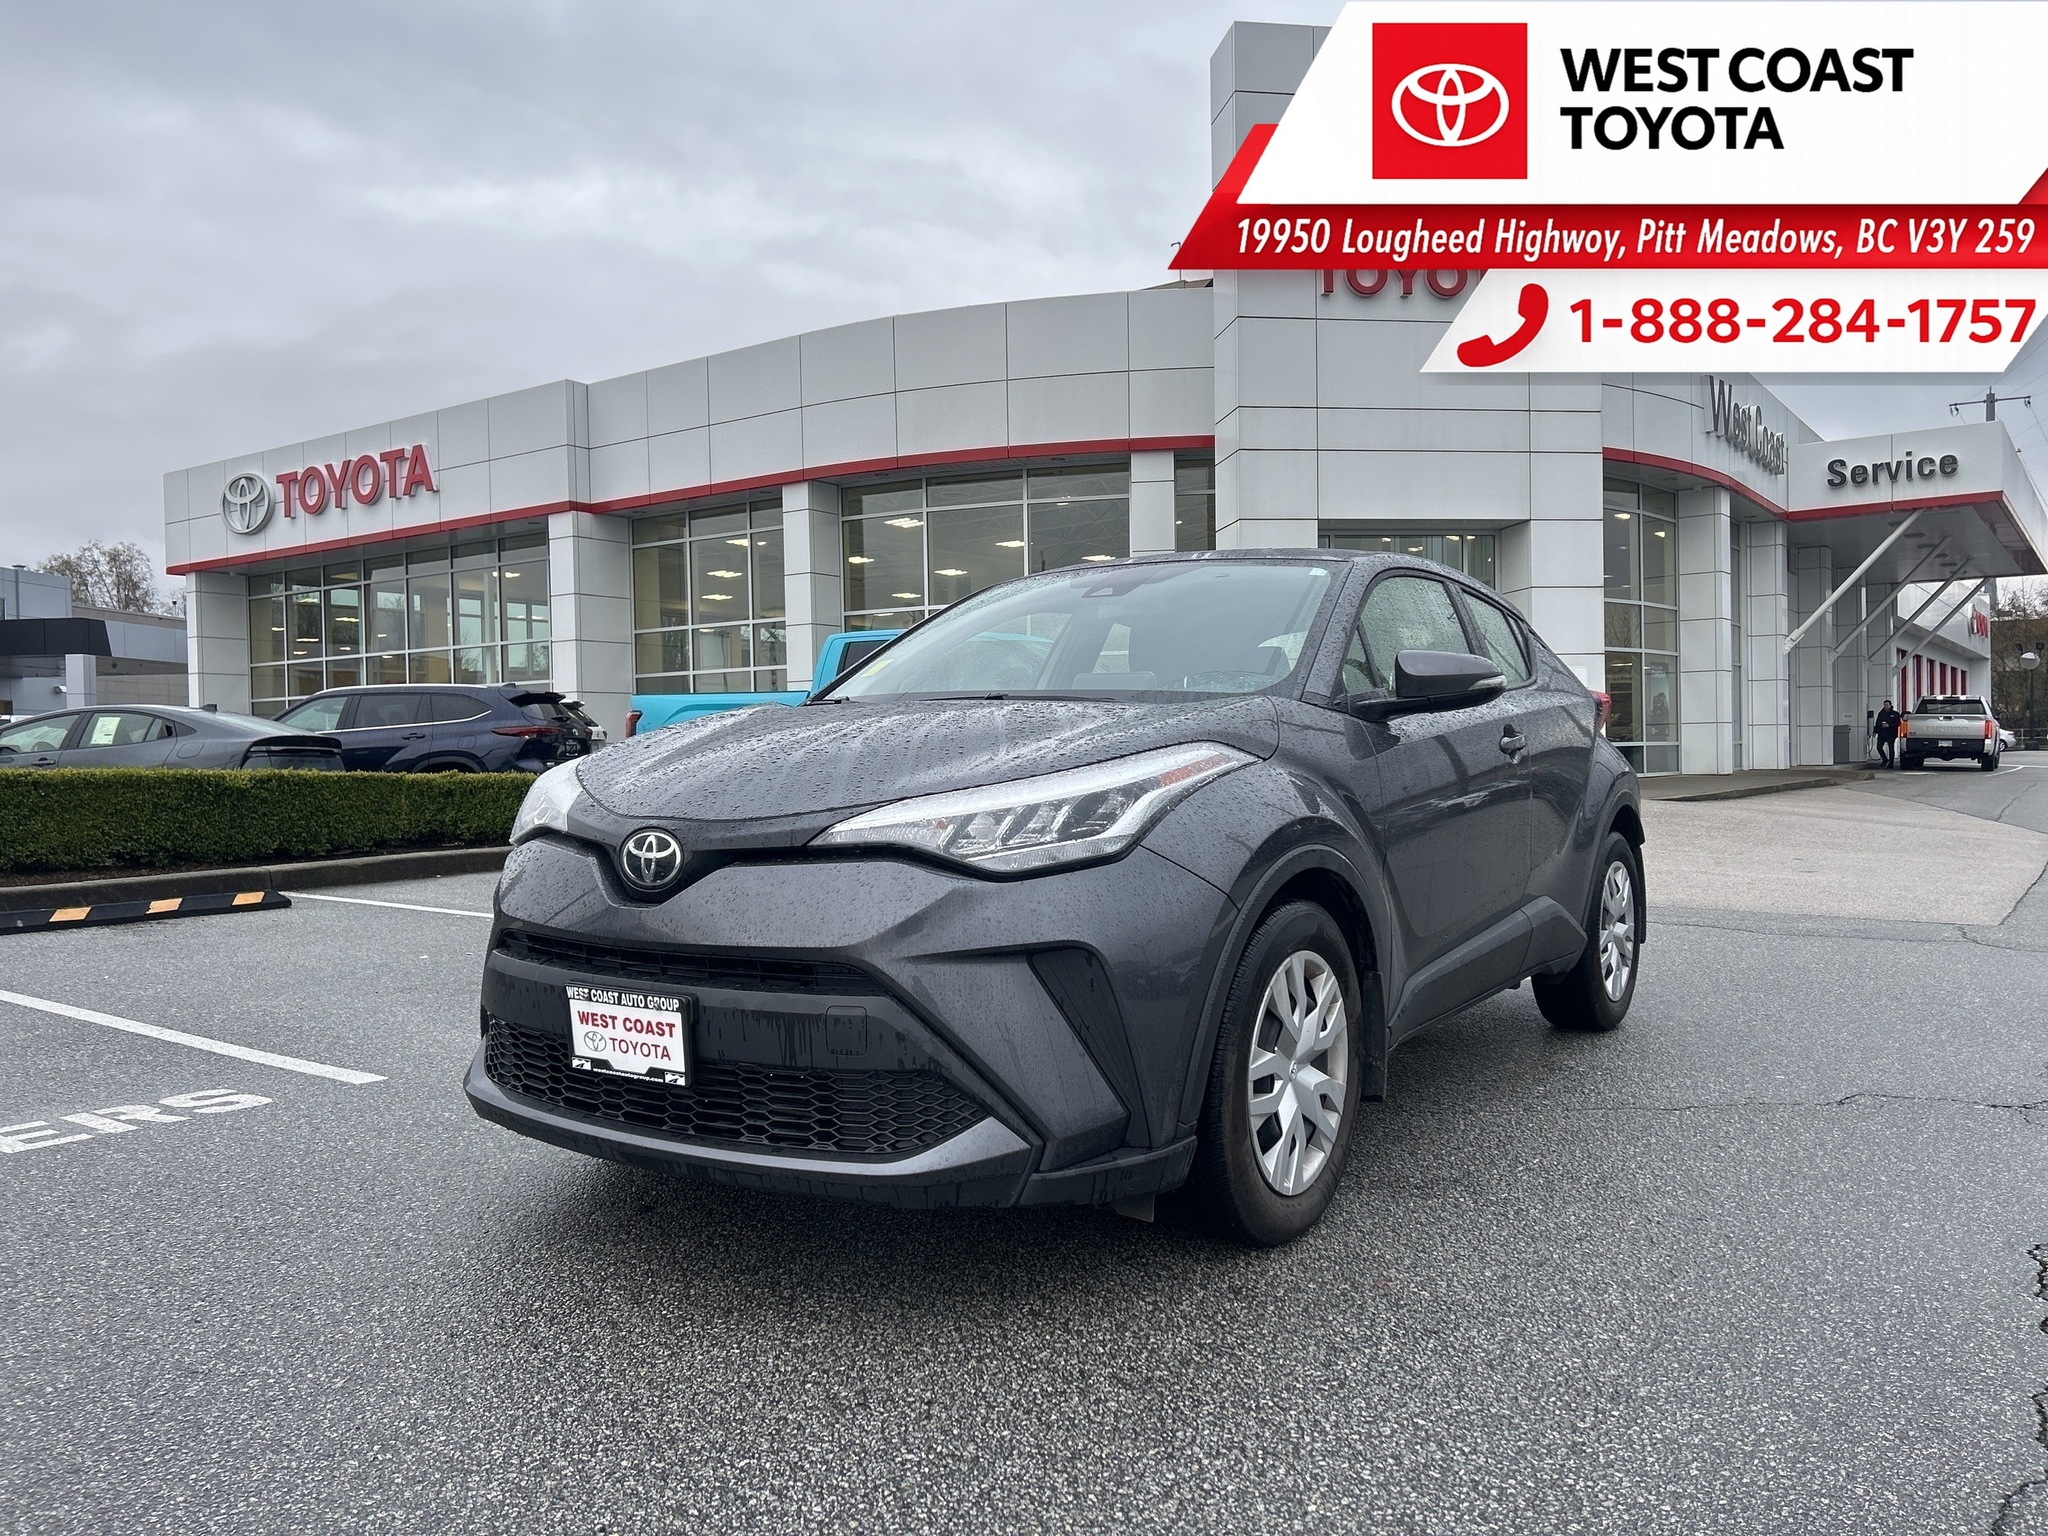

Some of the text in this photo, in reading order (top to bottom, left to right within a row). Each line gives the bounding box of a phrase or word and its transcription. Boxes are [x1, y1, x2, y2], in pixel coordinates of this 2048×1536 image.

[1701, 374, 1752, 452] West
[276, 444, 439, 519] TOYOTA
[1826, 450, 1959, 489] Service
[591, 989, 618, 1005] COAST
[621, 993, 645, 1008] AUTO
[577, 1010, 676, 1038] WEST COAST
[608, 1037, 672, 1061] TOYOTA
